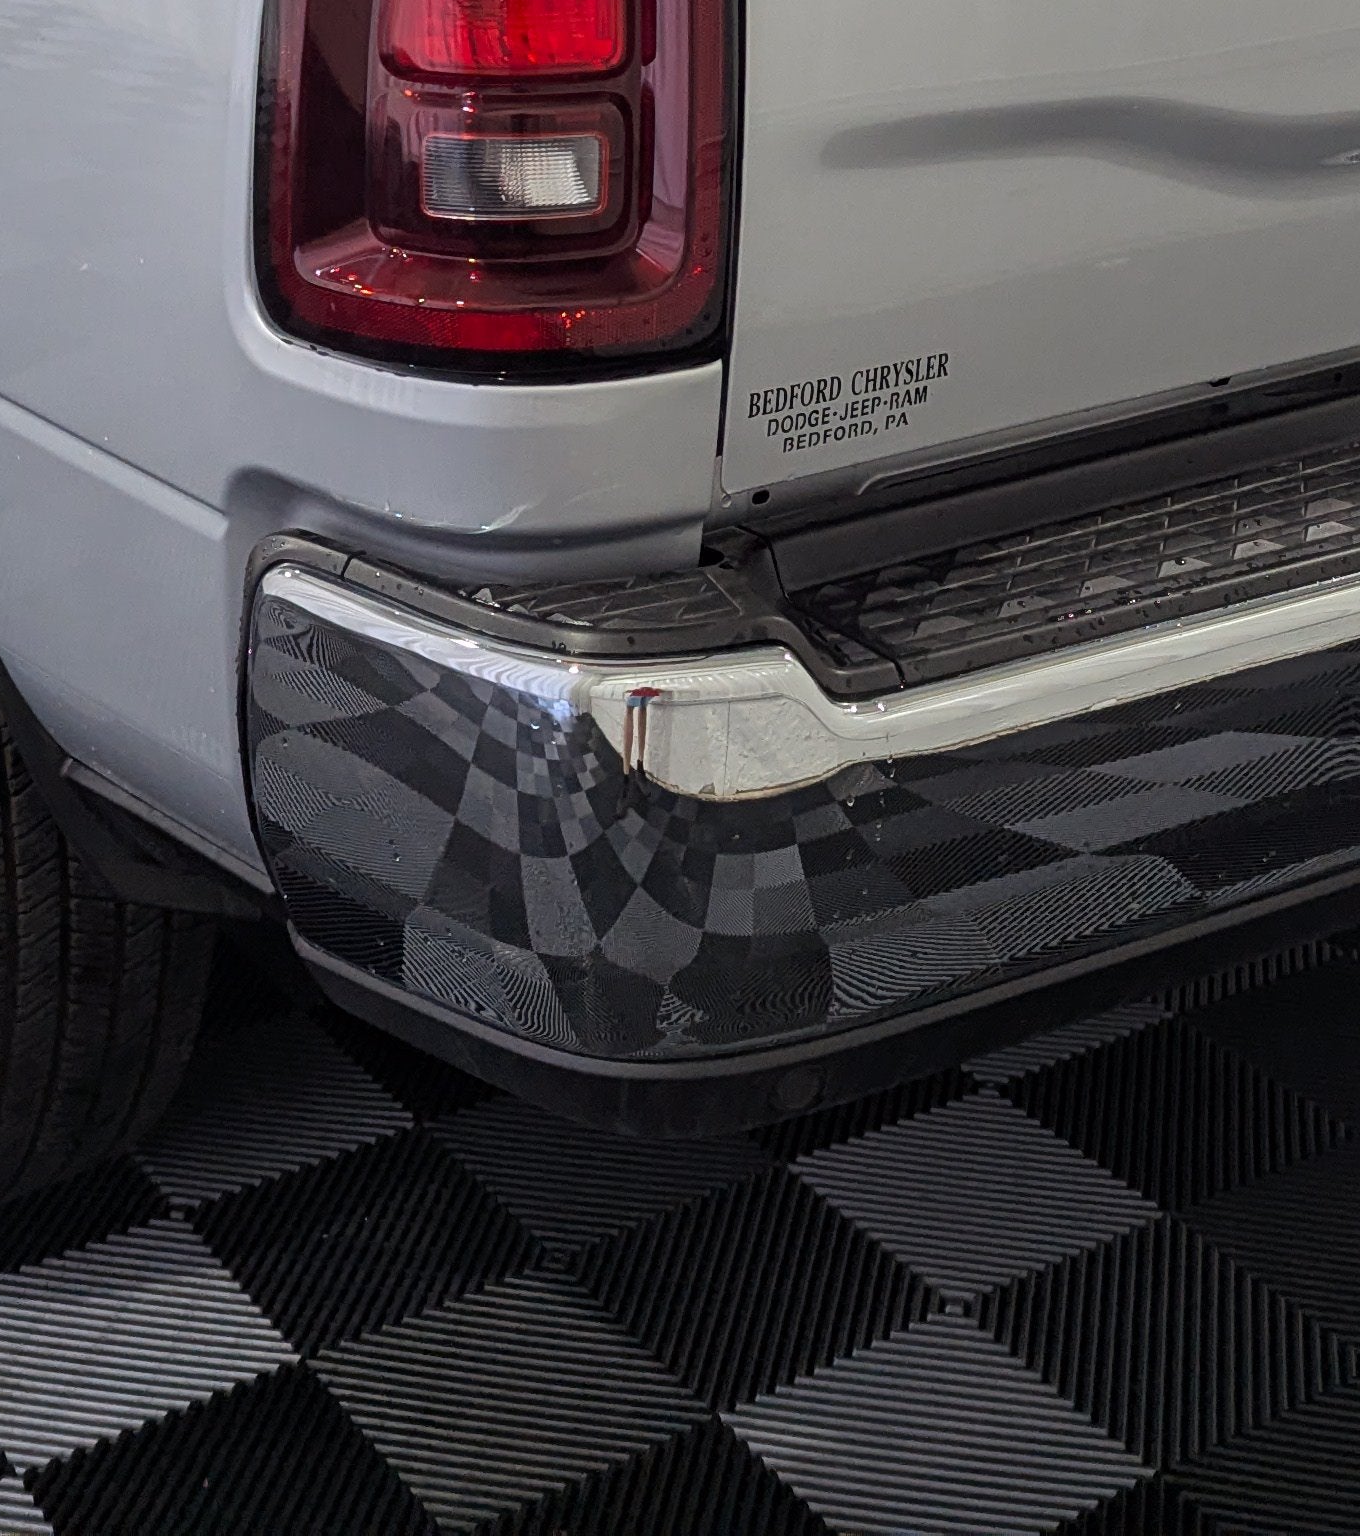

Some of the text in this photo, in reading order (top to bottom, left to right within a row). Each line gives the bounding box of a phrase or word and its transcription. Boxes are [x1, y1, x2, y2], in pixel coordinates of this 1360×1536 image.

[747, 352, 950, 419] BEDFORD CHRYSLER
[782, 412, 909, 454] BEDFORD, PA
